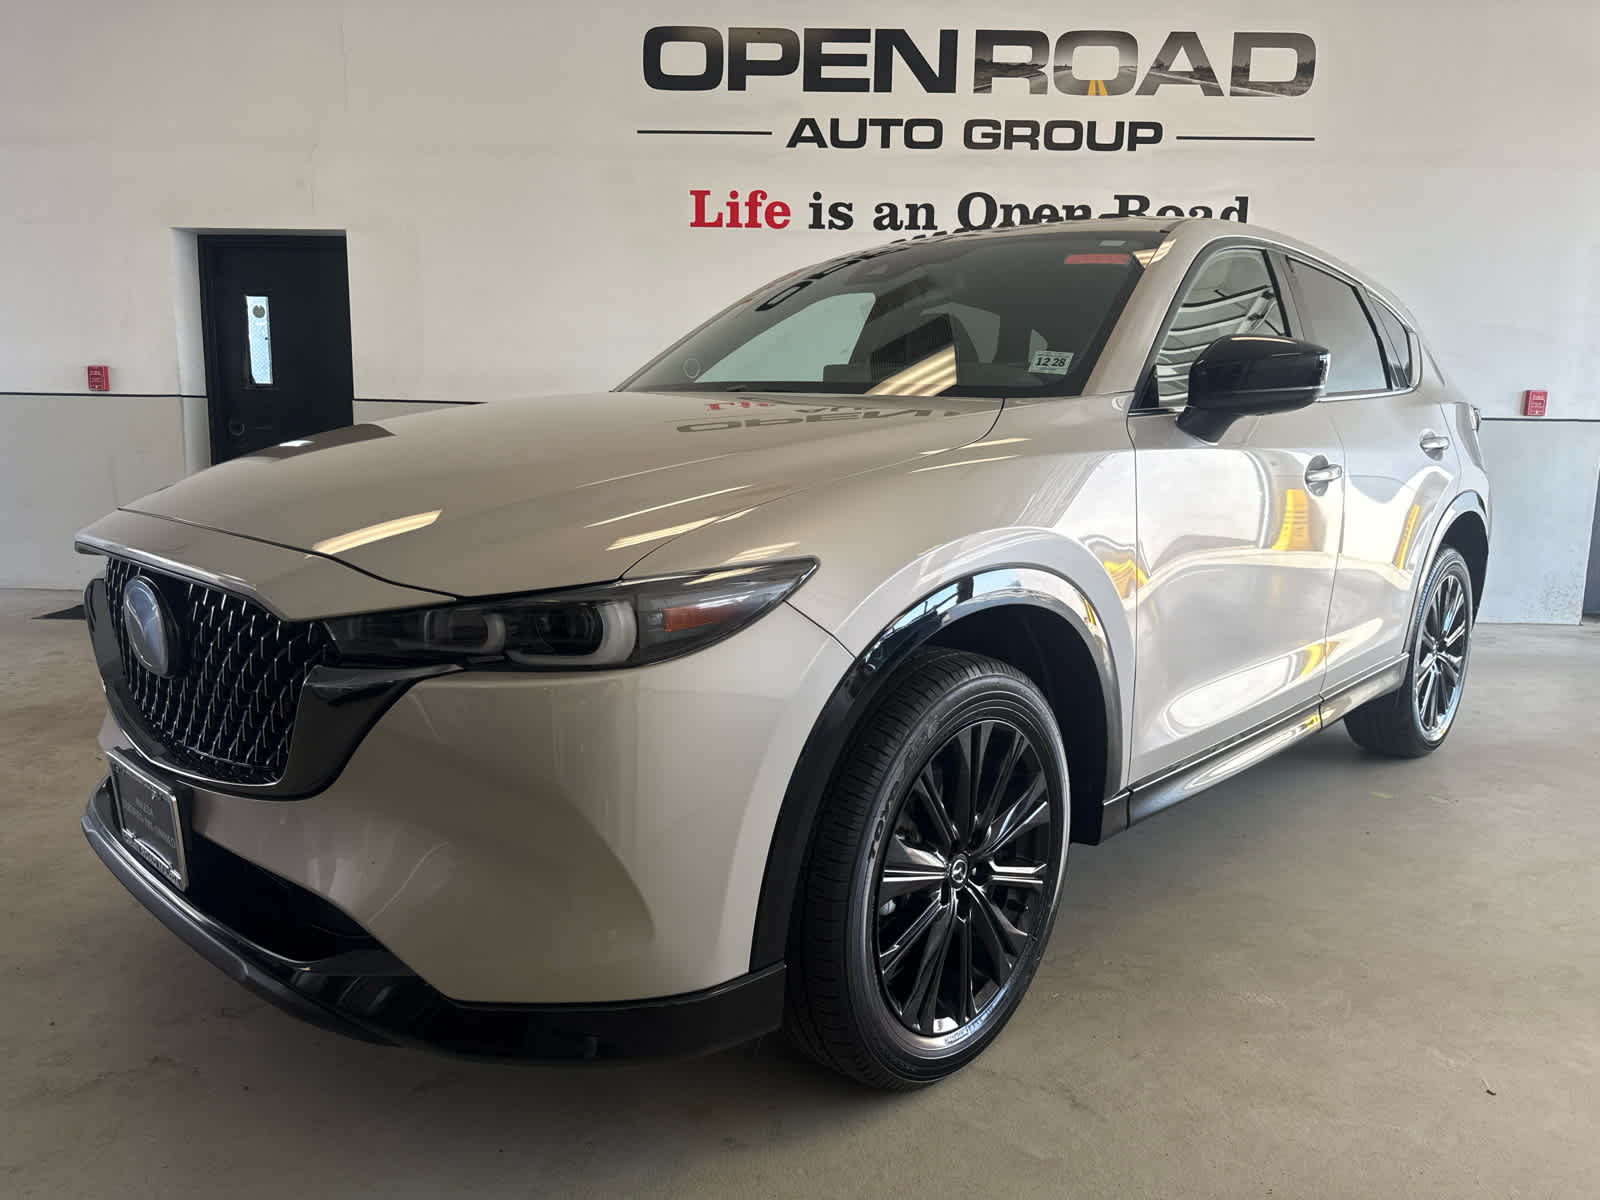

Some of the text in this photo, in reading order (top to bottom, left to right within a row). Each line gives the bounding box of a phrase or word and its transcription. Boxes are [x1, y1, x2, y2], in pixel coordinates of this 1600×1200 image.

[643, 26, 1317, 97] OPEN ROAD
[786, 117, 1163, 152] AUTO GROUP
[689, 189, 791, 229] Life
[808, 191, 854, 230] is
[873, 202, 938, 231] an
[1035, 357, 1067, 367] 12 28
